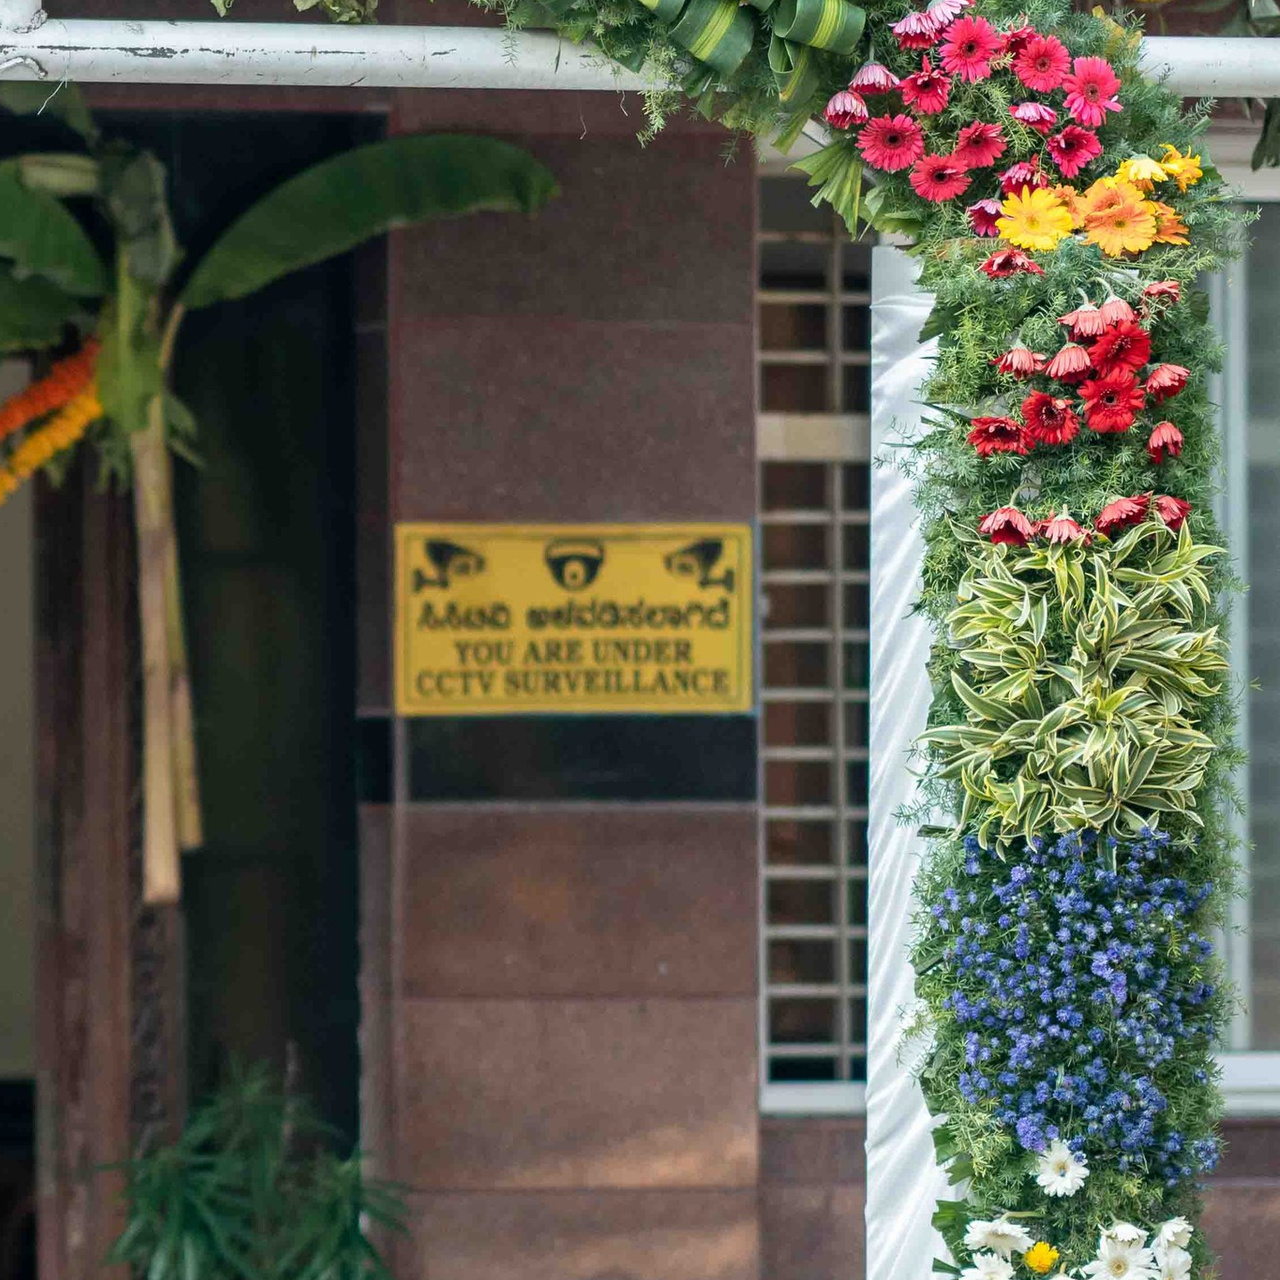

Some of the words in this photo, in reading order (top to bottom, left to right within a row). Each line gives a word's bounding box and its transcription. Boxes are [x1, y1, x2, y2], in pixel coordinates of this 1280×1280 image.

[454, 639, 514, 666] YOU
[523, 639, 583, 665] ARE
[592, 639, 692, 665] UNDER
[416, 669, 495, 696] CCTV
[504, 668, 729, 696] SURVEILLANCE
